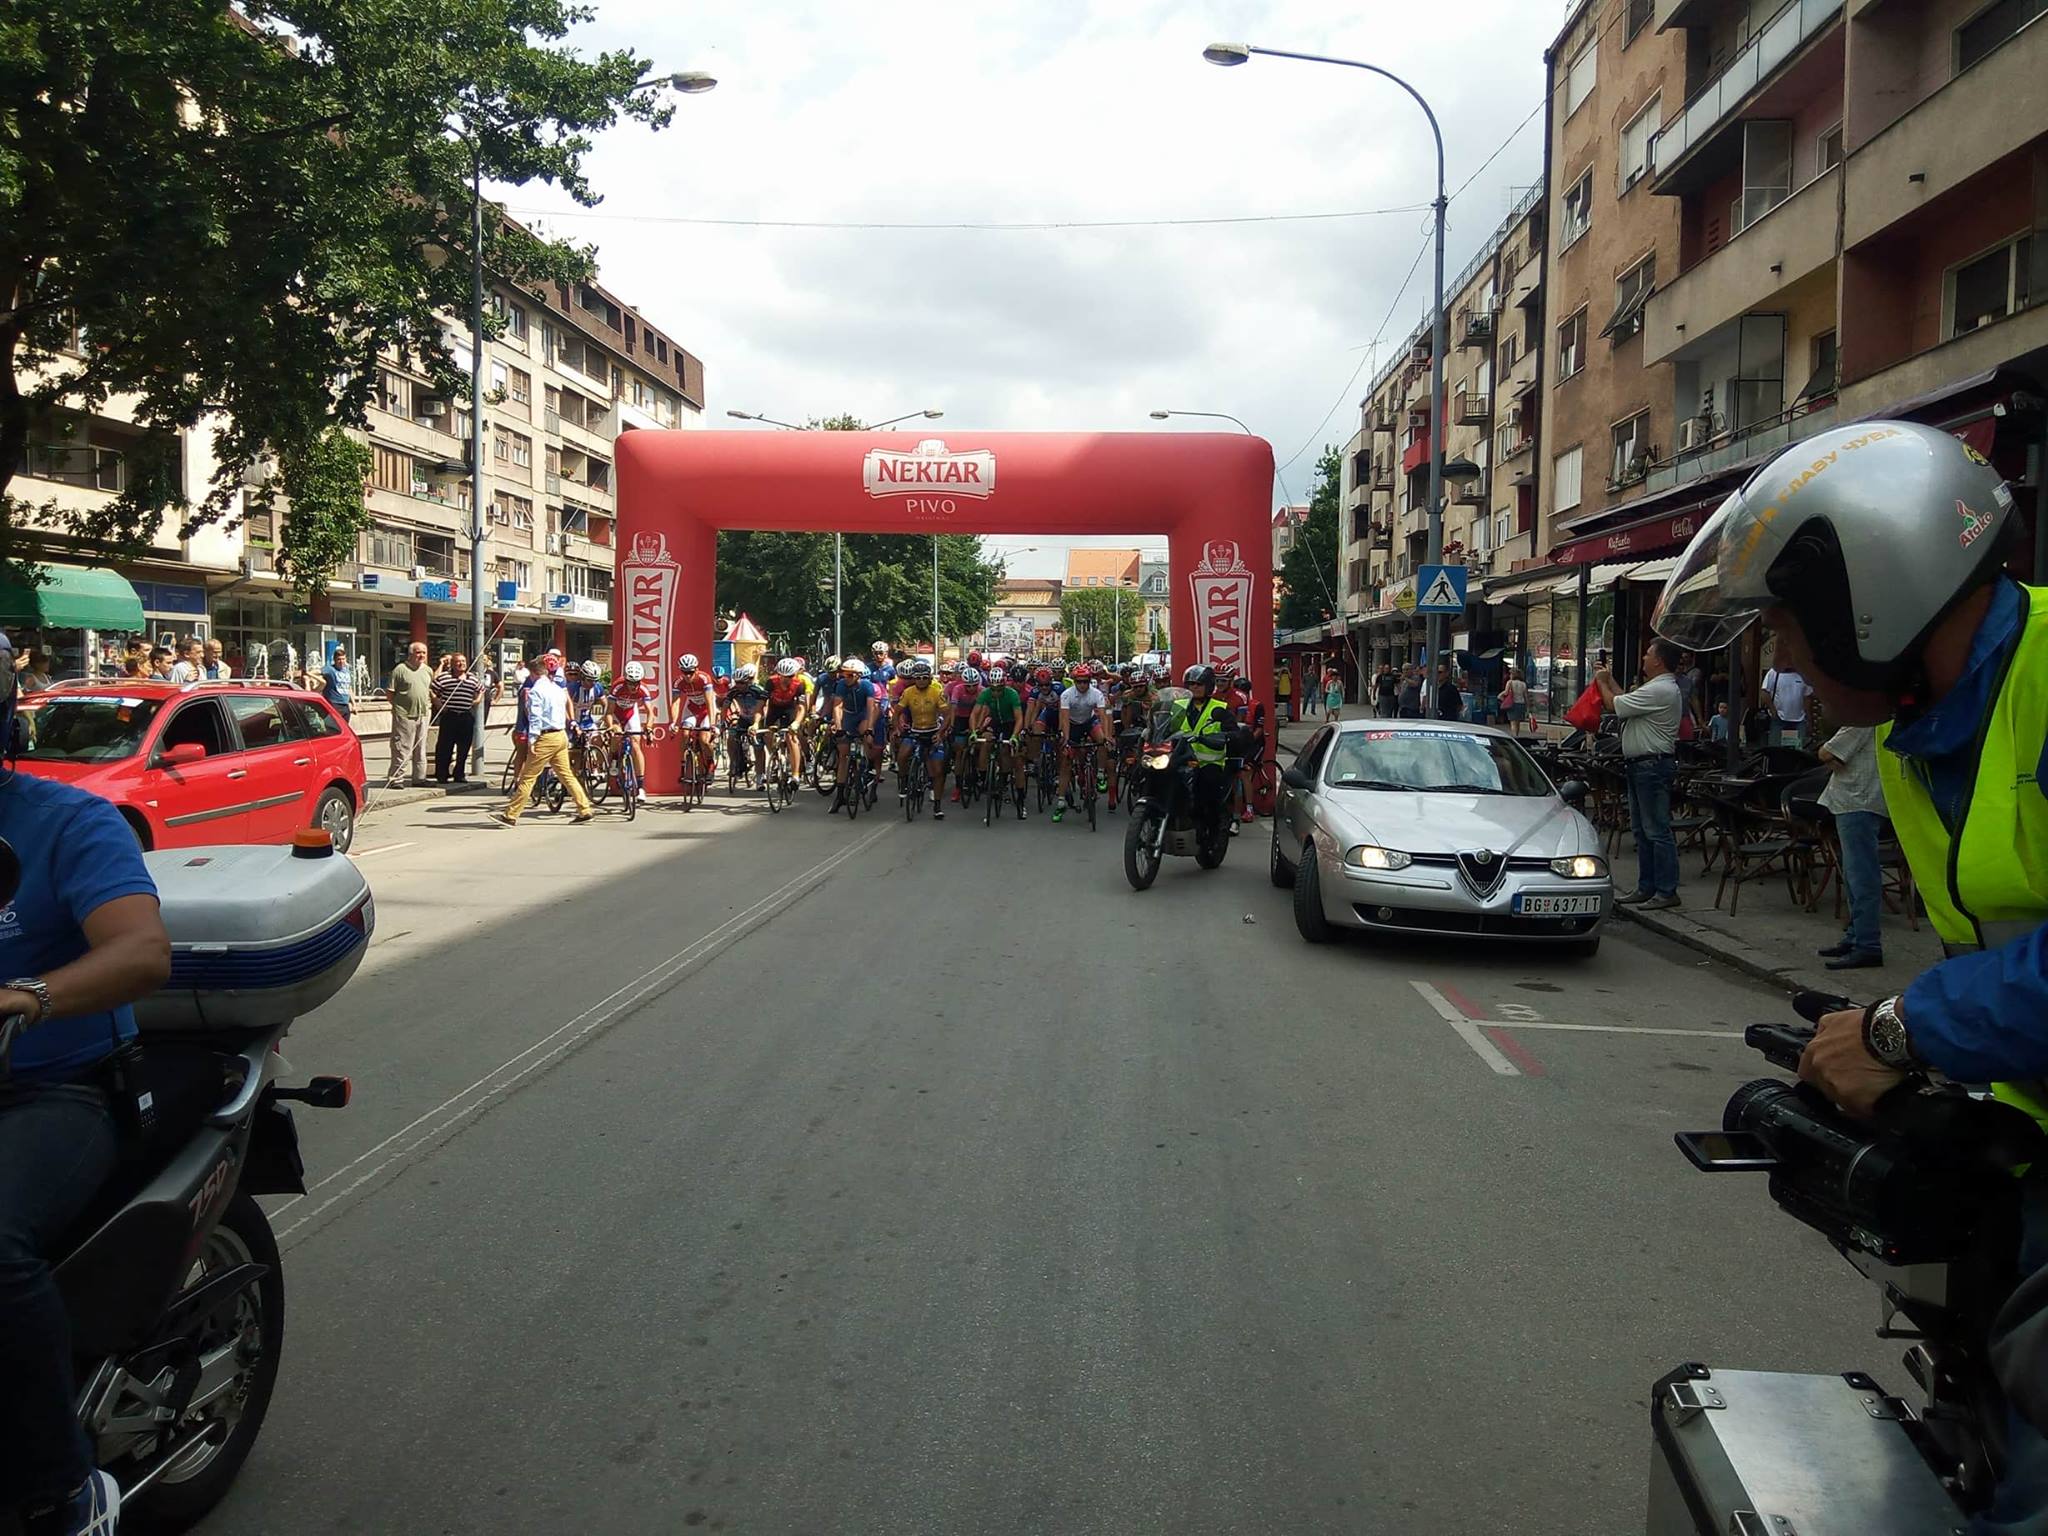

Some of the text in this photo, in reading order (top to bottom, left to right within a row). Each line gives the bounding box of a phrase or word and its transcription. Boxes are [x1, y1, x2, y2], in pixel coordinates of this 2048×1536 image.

[877, 458, 981, 483] NEKTAR
[906, 499, 957, 514] PIVO
[1960, 512, 1993, 548] Atako
[1524, 898, 1542, 912] BG
